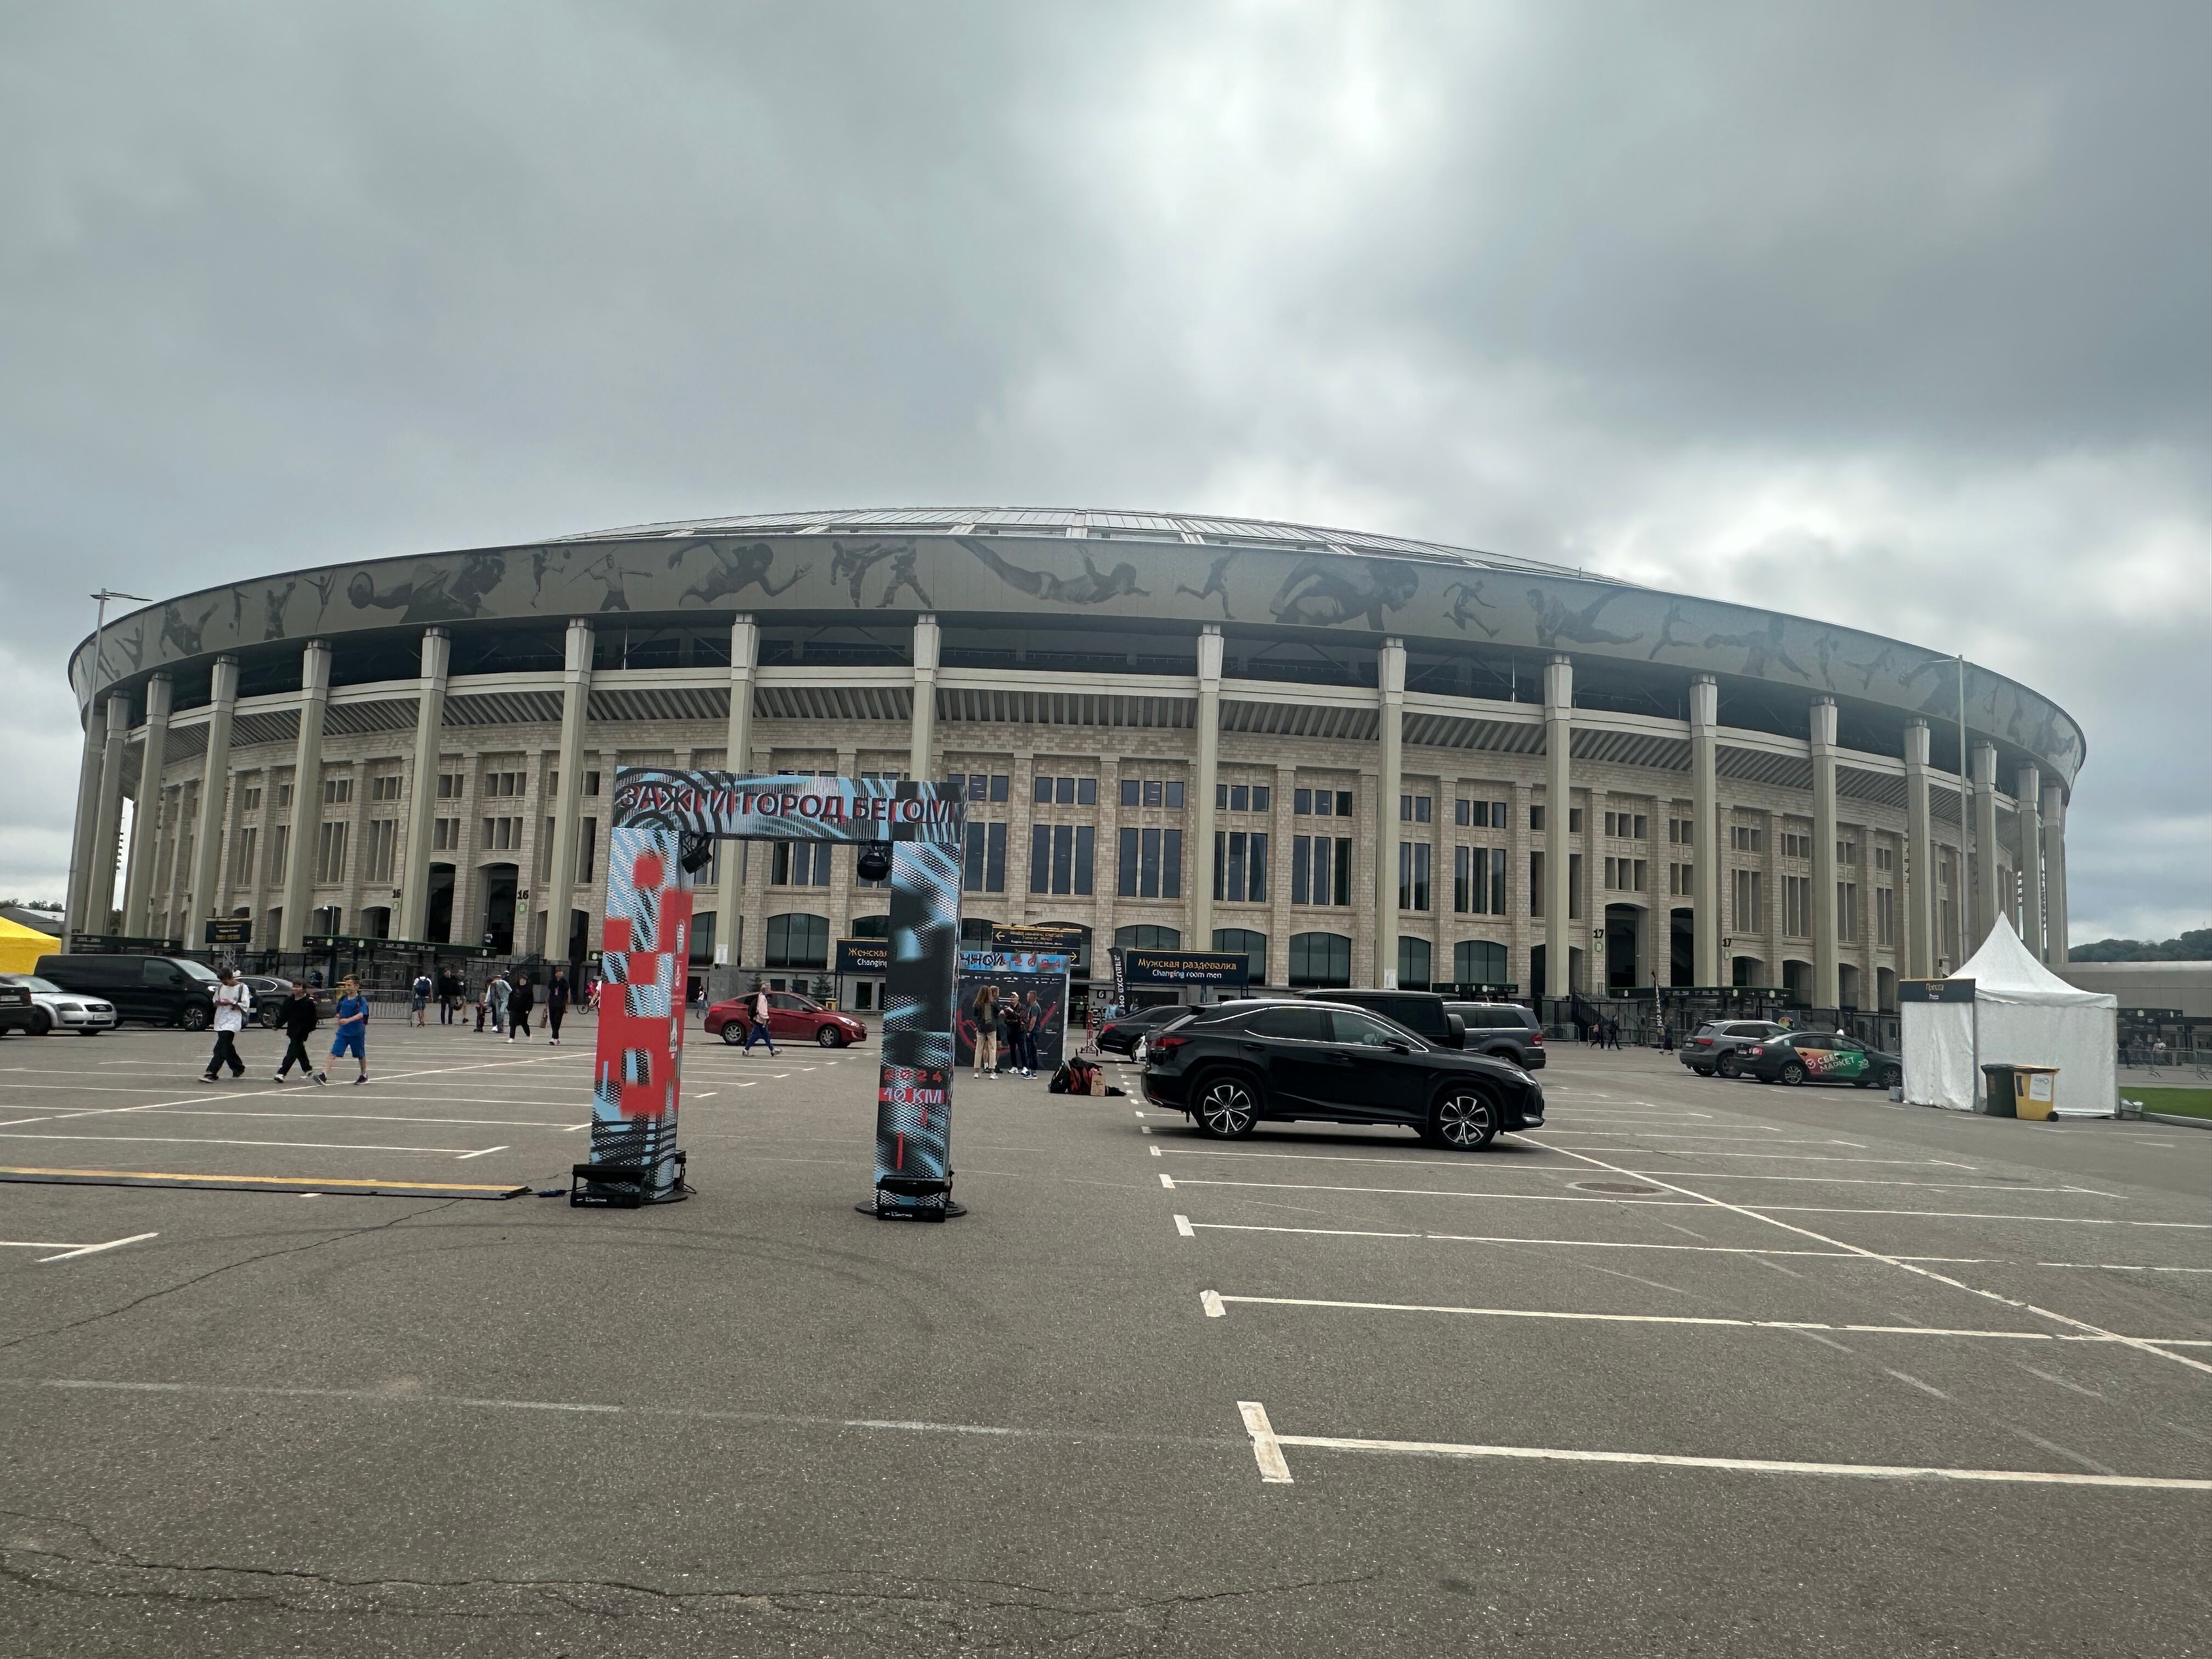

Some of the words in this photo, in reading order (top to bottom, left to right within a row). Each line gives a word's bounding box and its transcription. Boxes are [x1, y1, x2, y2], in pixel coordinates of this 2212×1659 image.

[742, 792, 846, 823] ГОРОД
[852, 797, 956, 823] БЕГОМ
[517, 890, 529, 900] 16
[1138, 958, 1180, 969] Мужская
[1152, 969, 1185, 979] Changing
